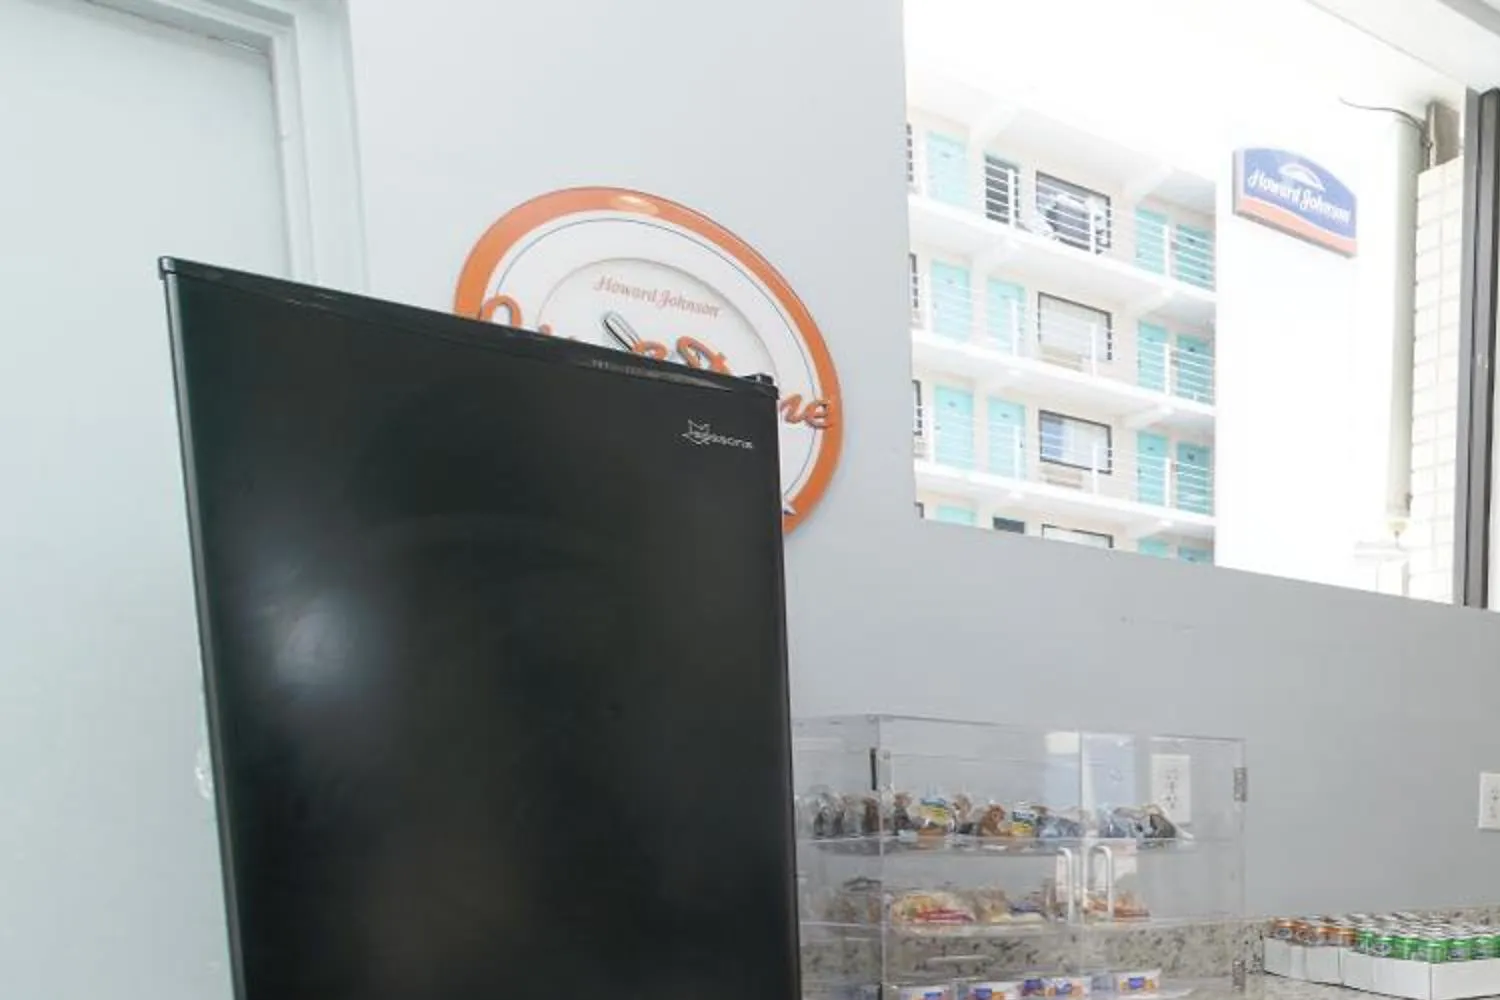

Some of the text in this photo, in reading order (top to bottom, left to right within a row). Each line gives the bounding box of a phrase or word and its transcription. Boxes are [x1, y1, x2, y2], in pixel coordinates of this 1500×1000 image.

[1247, 168, 1351, 223] Howard Johnson
[593, 276, 720, 317] Howard Johnson
